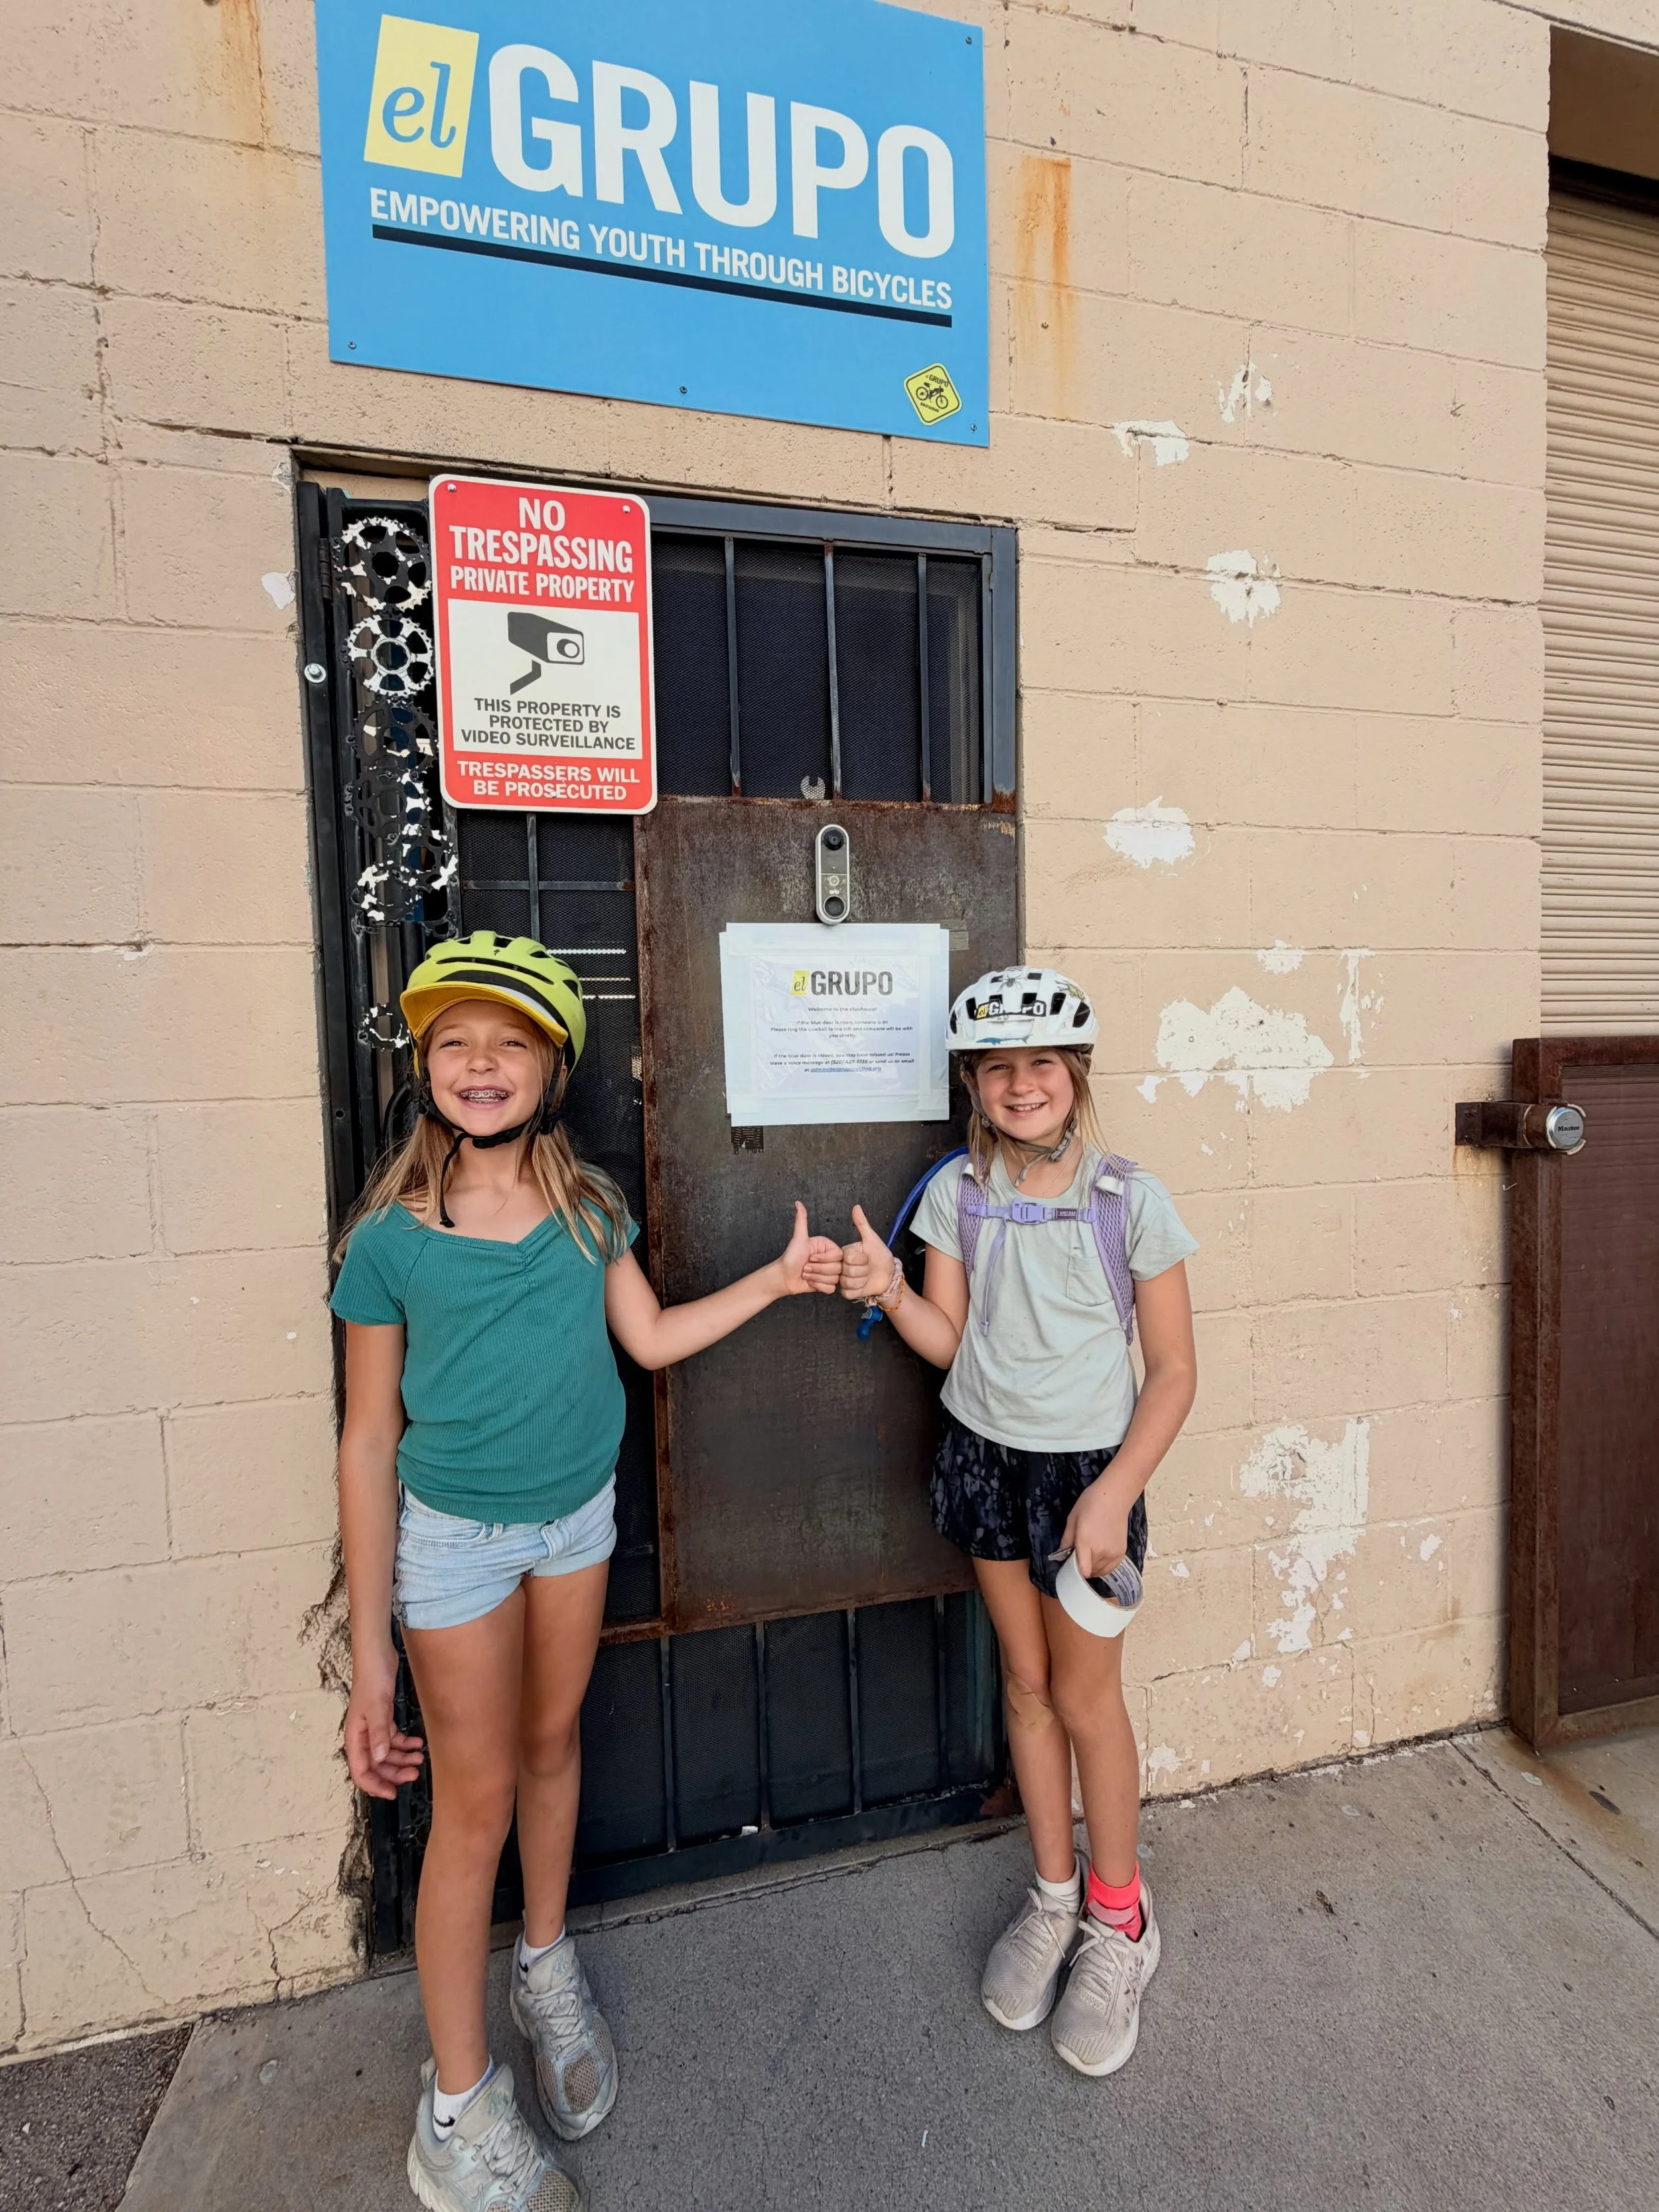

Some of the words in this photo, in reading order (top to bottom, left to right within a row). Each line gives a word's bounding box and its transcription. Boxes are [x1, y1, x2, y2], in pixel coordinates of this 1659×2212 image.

[382, 61, 457, 149] el
[488, 44, 955, 258] GRUPO
[370, 187, 580, 250] EMPOWERING
[588, 224, 685, 267] YOUTH
[694, 242, 823, 290] THROUGH
[832, 265, 953, 309] BICYCLES
[929, 374, 948, 388] GRUPO
[518, 497, 565, 532] NO
[449, 525, 633, 573] TRESPASSING
[451, 565, 530, 595] PRIVATE
[536, 573, 635, 603] PROPERTY
[474, 698, 512, 713] THIS
[517, 701, 601, 717] PROPERTY
[607, 705, 621, 718] IS
[489, 715, 583, 733] PROTECTED
[589, 721, 609, 733] BY
[461, 729, 511, 745] VIDEO
[516, 733, 636, 750] SURVEILLANCE
[457, 761, 592, 782] TRESPASSERS
[597, 767, 640, 783] WILL
[473, 780, 499, 795] BE
[505, 782, 627, 800] PROSECUTED
[794, 976, 806, 992] el
[811, 970, 893, 995] GRUPO
